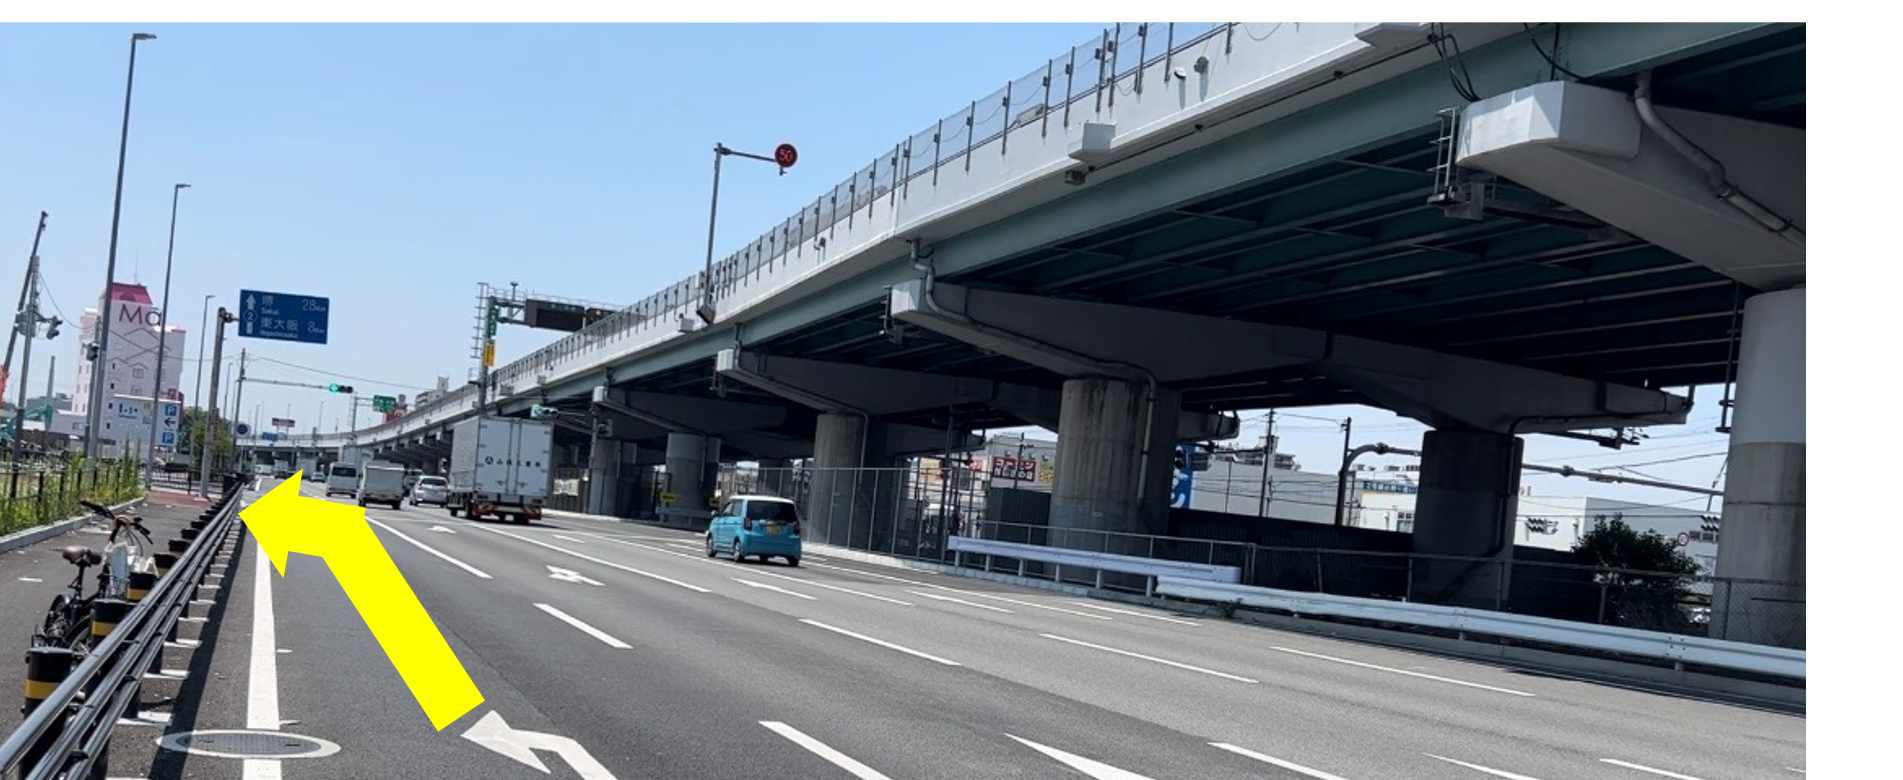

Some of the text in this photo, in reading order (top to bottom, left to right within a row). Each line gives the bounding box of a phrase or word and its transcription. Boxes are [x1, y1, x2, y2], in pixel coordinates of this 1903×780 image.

[780, 149, 793, 162] 50
[260, 317, 299, 332] 東大阪
